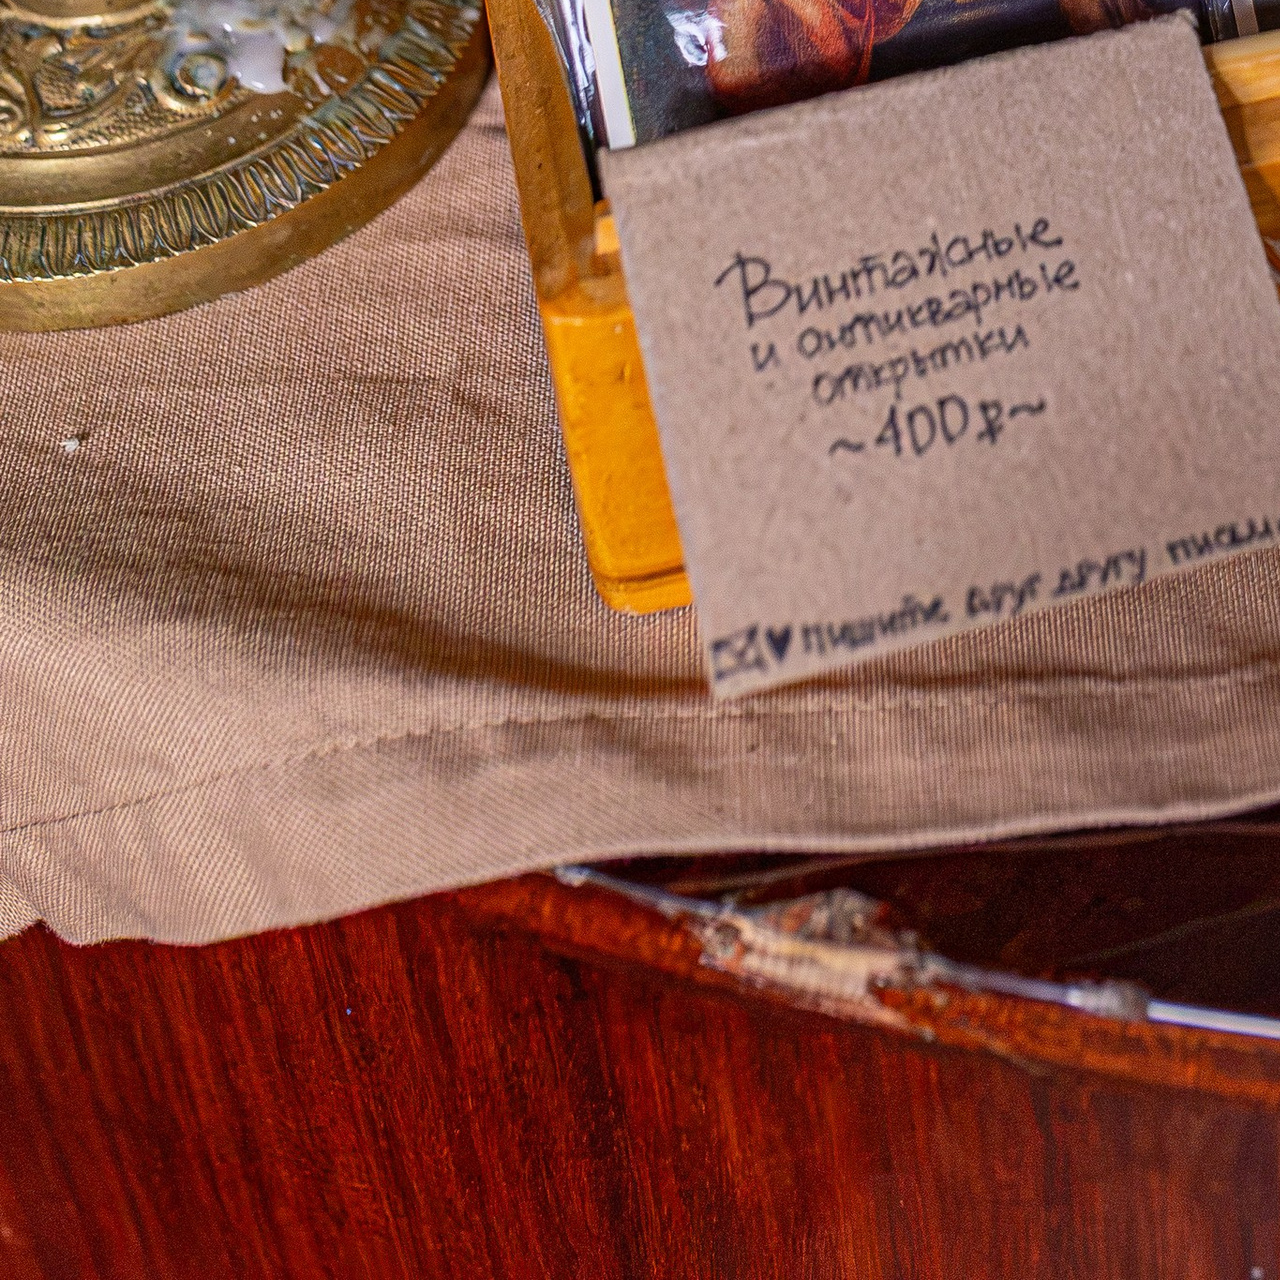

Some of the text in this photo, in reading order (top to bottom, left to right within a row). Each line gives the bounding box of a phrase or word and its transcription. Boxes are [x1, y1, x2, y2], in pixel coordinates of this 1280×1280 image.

[714, 217, 1063, 328] Винтажные
[751, 259, 1081, 372] и антикварные
[811, 323, 1031, 405] открытки
